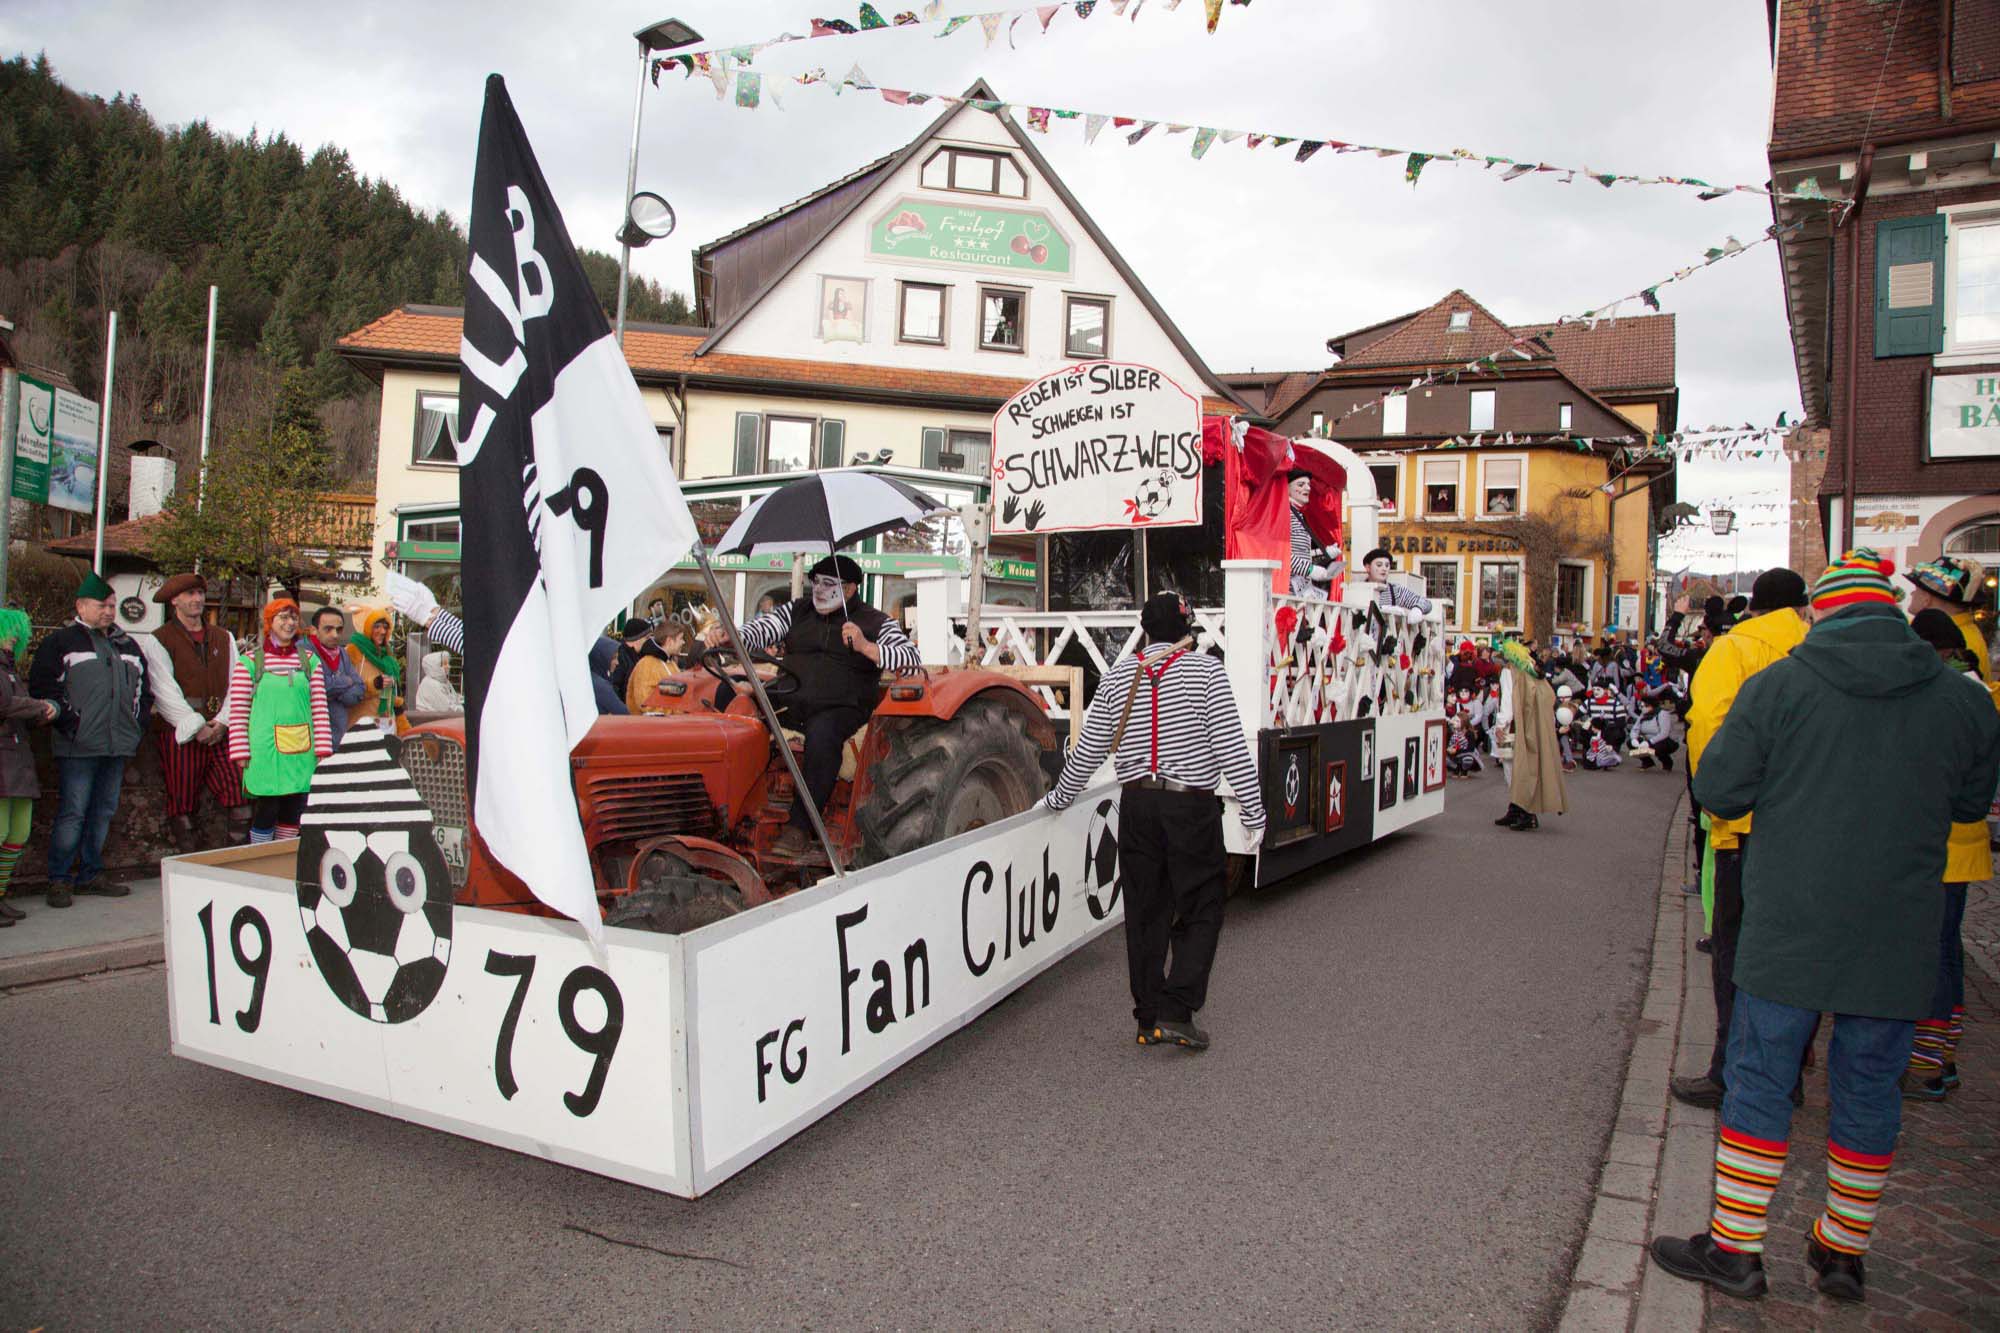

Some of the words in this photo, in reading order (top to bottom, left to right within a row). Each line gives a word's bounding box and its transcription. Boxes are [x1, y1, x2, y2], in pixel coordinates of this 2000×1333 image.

[930, 246, 1011, 265] Restaurant
[1008, 379, 1061, 425] REDEN
[1065, 374, 1084, 391] IST
[1089, 365, 1160, 394] SILBER
[1976, 378, 2000, 396] H
[1032, 405, 1103, 439] SCHWEIGEN
[1111, 402, 1135, 419] IST
[1005, 430, 1202, 494] SCHWARZ-WEISS
[1379, 536, 1448, 553] BÄREN
[1458, 538, 1520, 552] PENSION
[756, 1016, 808, 1103] FG
[835, 902, 930, 1056] Fan
[961, 842, 1061, 977] Club
[197, 900, 272, 1033] 19
[484, 948, 624, 1118] 79
